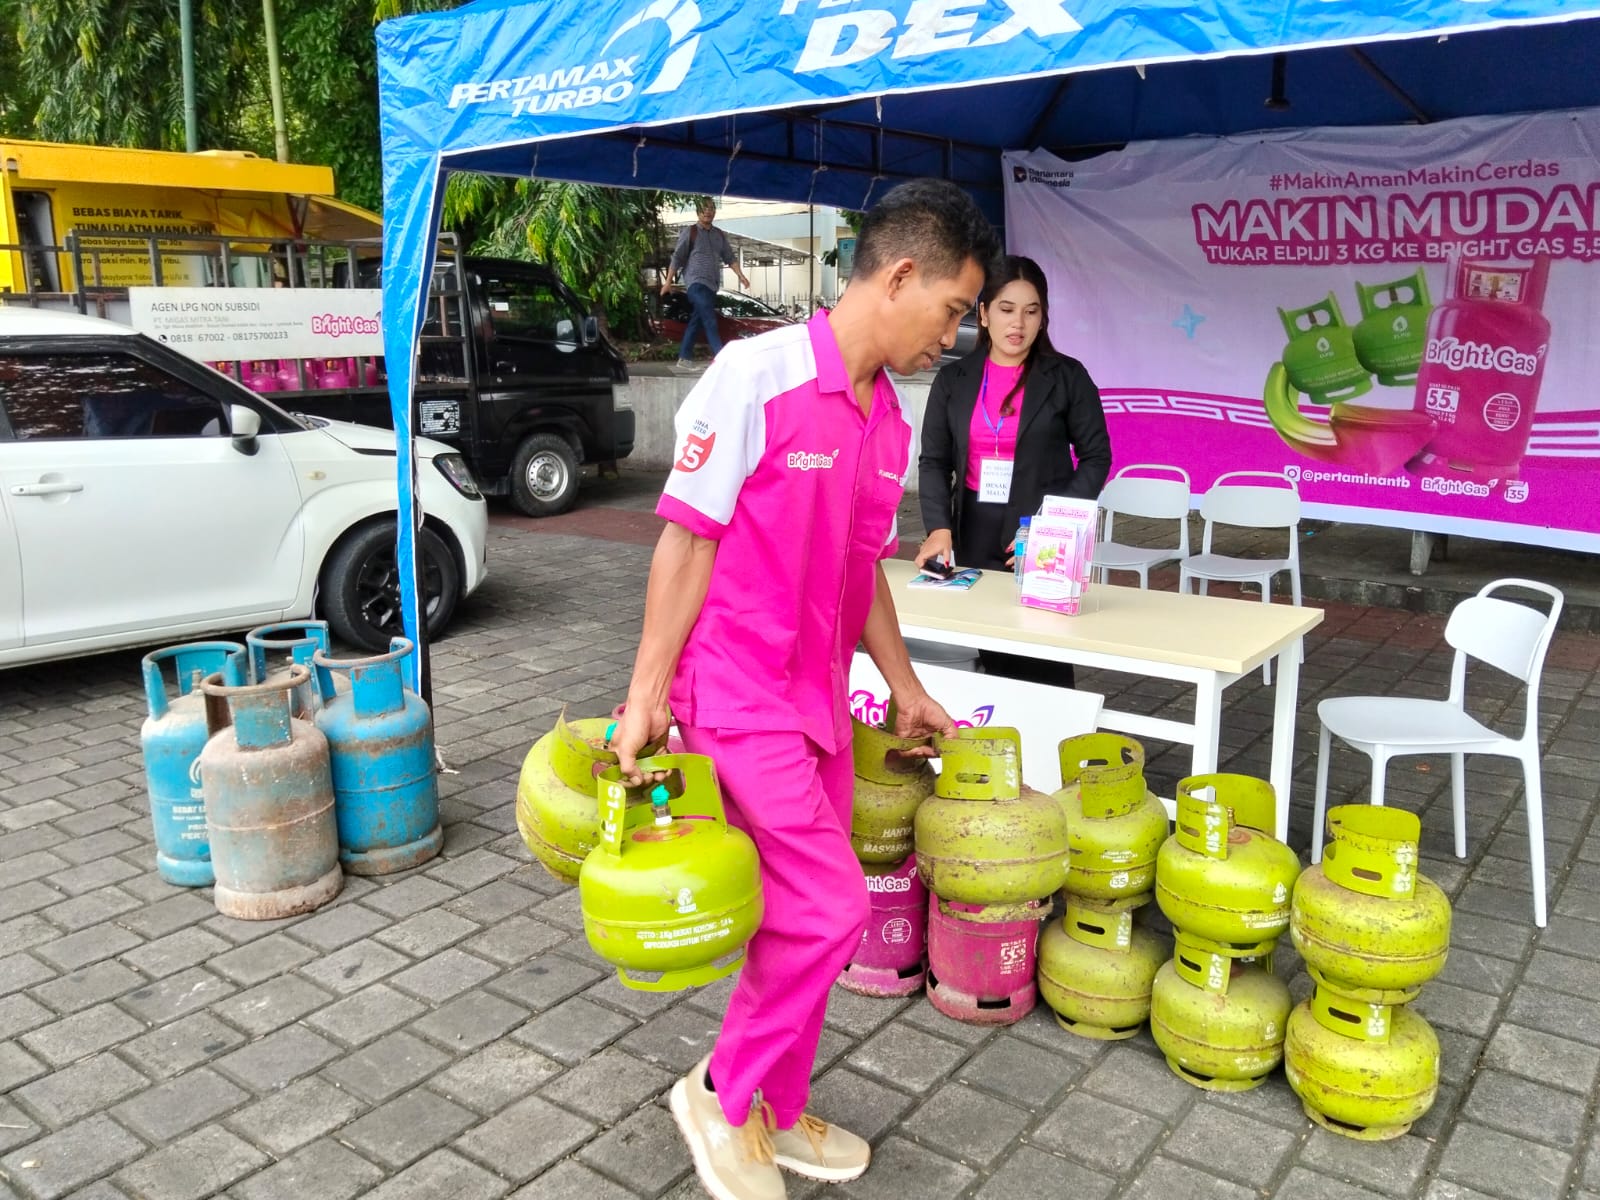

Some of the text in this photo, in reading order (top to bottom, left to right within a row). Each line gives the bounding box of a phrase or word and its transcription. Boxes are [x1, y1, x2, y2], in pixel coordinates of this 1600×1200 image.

[794, 0, 1084, 73] DEX
[448, 55, 640, 108] PERTAMAX
[512, 81, 635, 117] TURBO
[1269, 160, 1560, 191] #MakinAmanMakinCerdas
[73, 208, 183, 219] BEBAS BIAYA TARIK
[1196, 200, 1373, 241] MAKIN
[1207, 245, 1267, 260] TUKAR
[1274, 245, 1329, 260] ELPIJI
[1336, 244, 1348, 260] 3
[1355, 243, 1385, 259] KG
[1391, 243, 1419, 258] KE
[1425, 239, 1510, 258] BRIGHT
[1517, 237, 1565, 255] GAS
[151, 302, 260, 312] AGEN LPG NON SUBSIDI
[170, 335, 193, 343] 0818
[198, 333, 225, 342] 67002
[312, 314, 352, 337] Bright
[352, 318, 379, 334] Gas
[1426, 337, 1493, 370] Bright
[1493, 346, 1537, 375] Gas
[788, 451, 833, 471] Bright Gas
[1303, 469, 1410, 489] @pertaminantb
[1421, 477, 1463, 496] Bright
[1463, 482, 1490, 497] Gas
[884, 874, 911, 893] Gas
